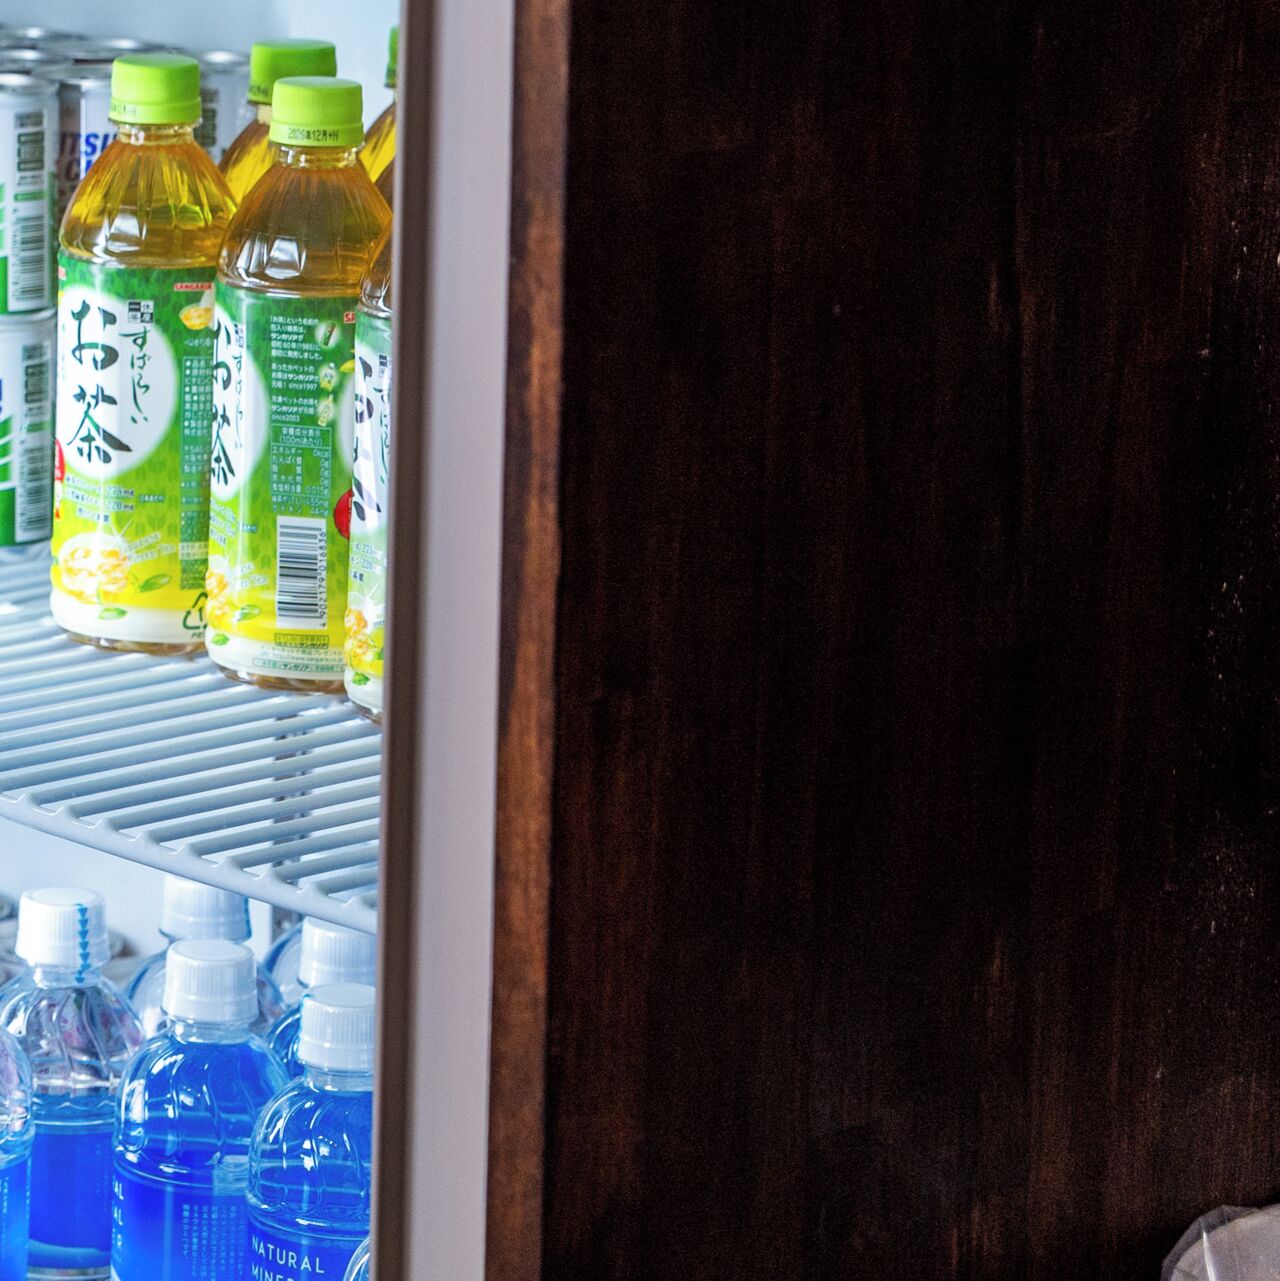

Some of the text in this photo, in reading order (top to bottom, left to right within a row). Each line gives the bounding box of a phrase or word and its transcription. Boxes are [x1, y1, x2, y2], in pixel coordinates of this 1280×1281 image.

[67, 299, 133, 465] お茶
[118, 326, 153, 424] すばらしい
[251, 1234, 325, 1275] NATURAL
